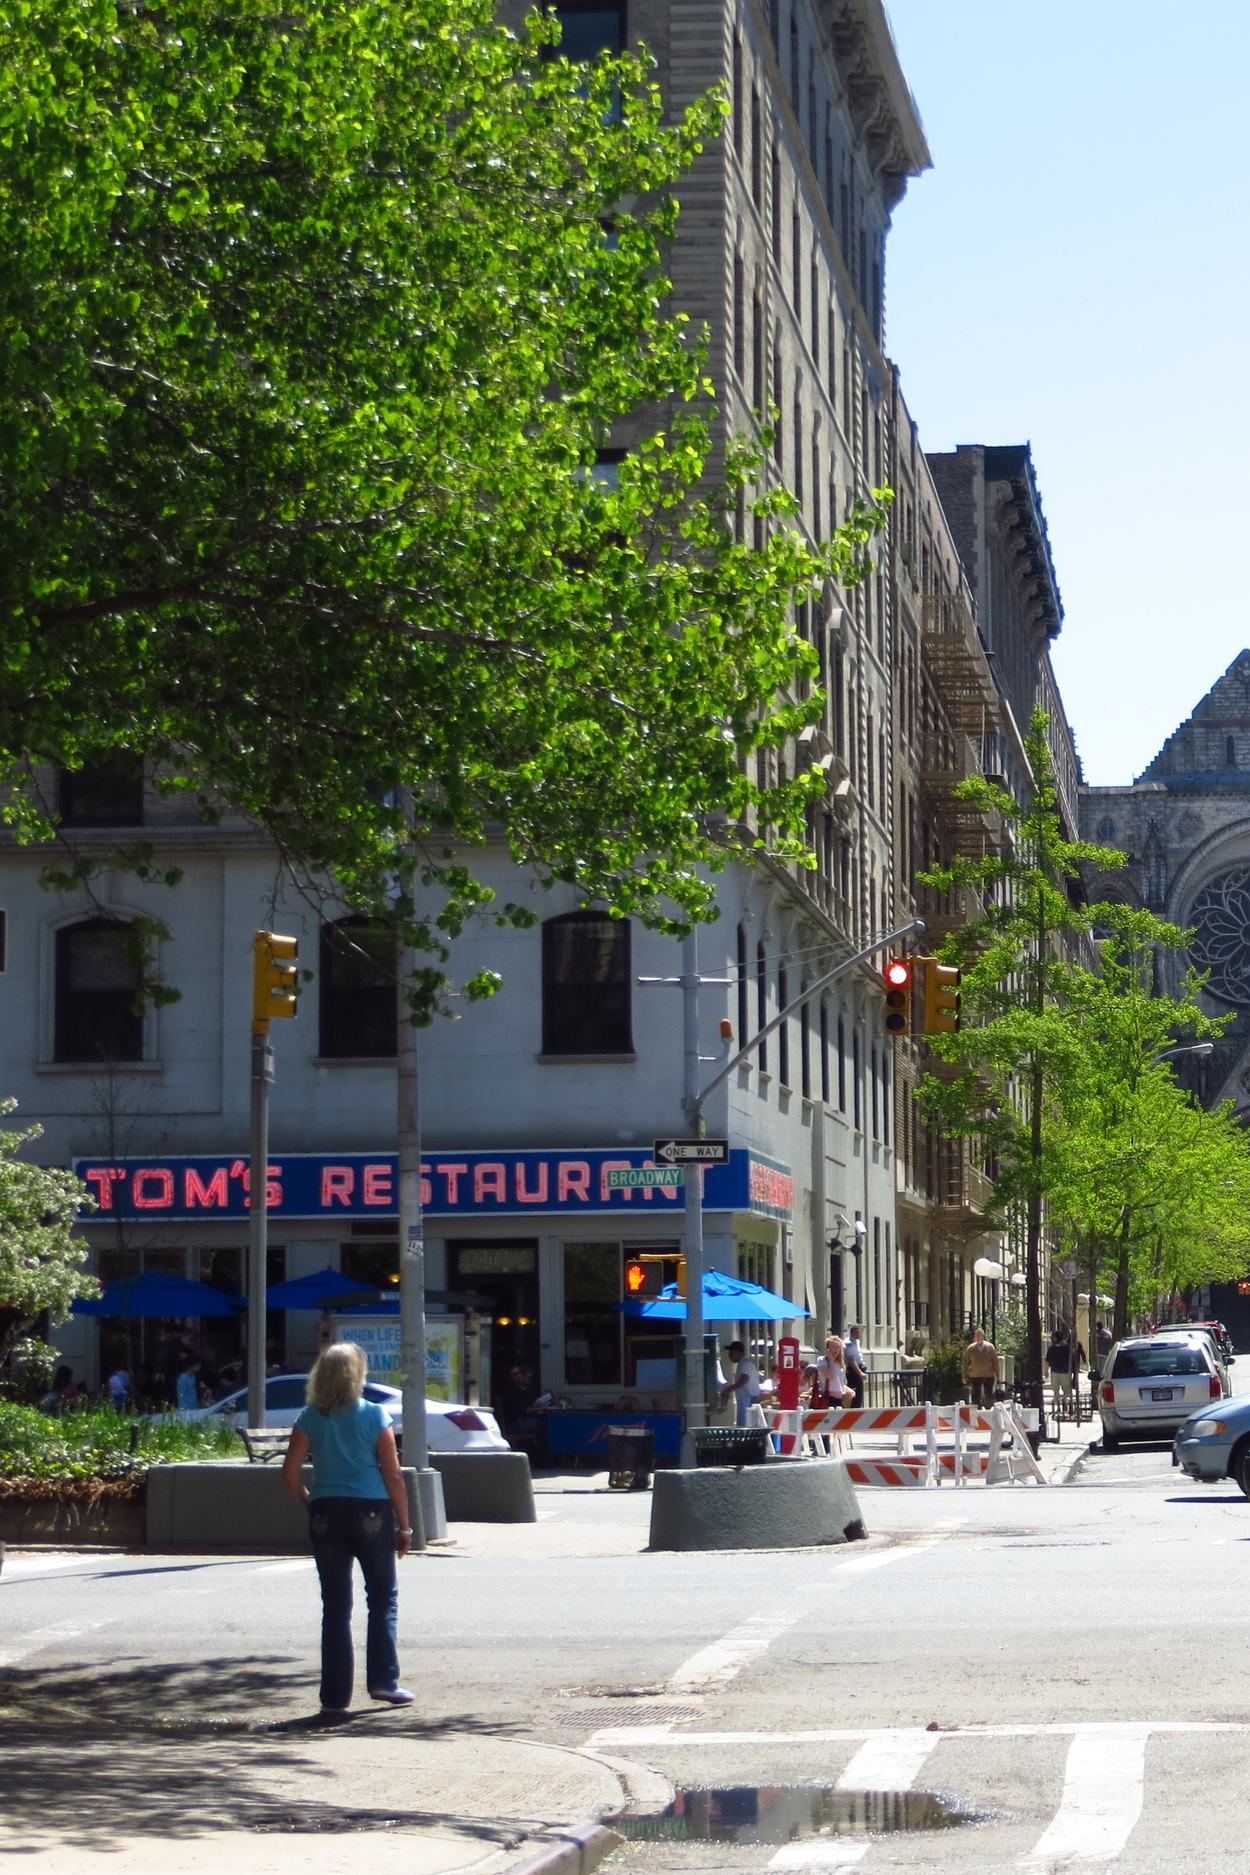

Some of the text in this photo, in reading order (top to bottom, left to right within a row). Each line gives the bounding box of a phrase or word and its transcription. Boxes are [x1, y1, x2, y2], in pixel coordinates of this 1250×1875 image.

[666, 1147, 719, 1157] ONE WAY
[86, 1160, 283, 1210] TOM'S
[609, 1169, 681, 1186] BROADWAY
[342, 1327, 401, 1342] WHEN LIFE
